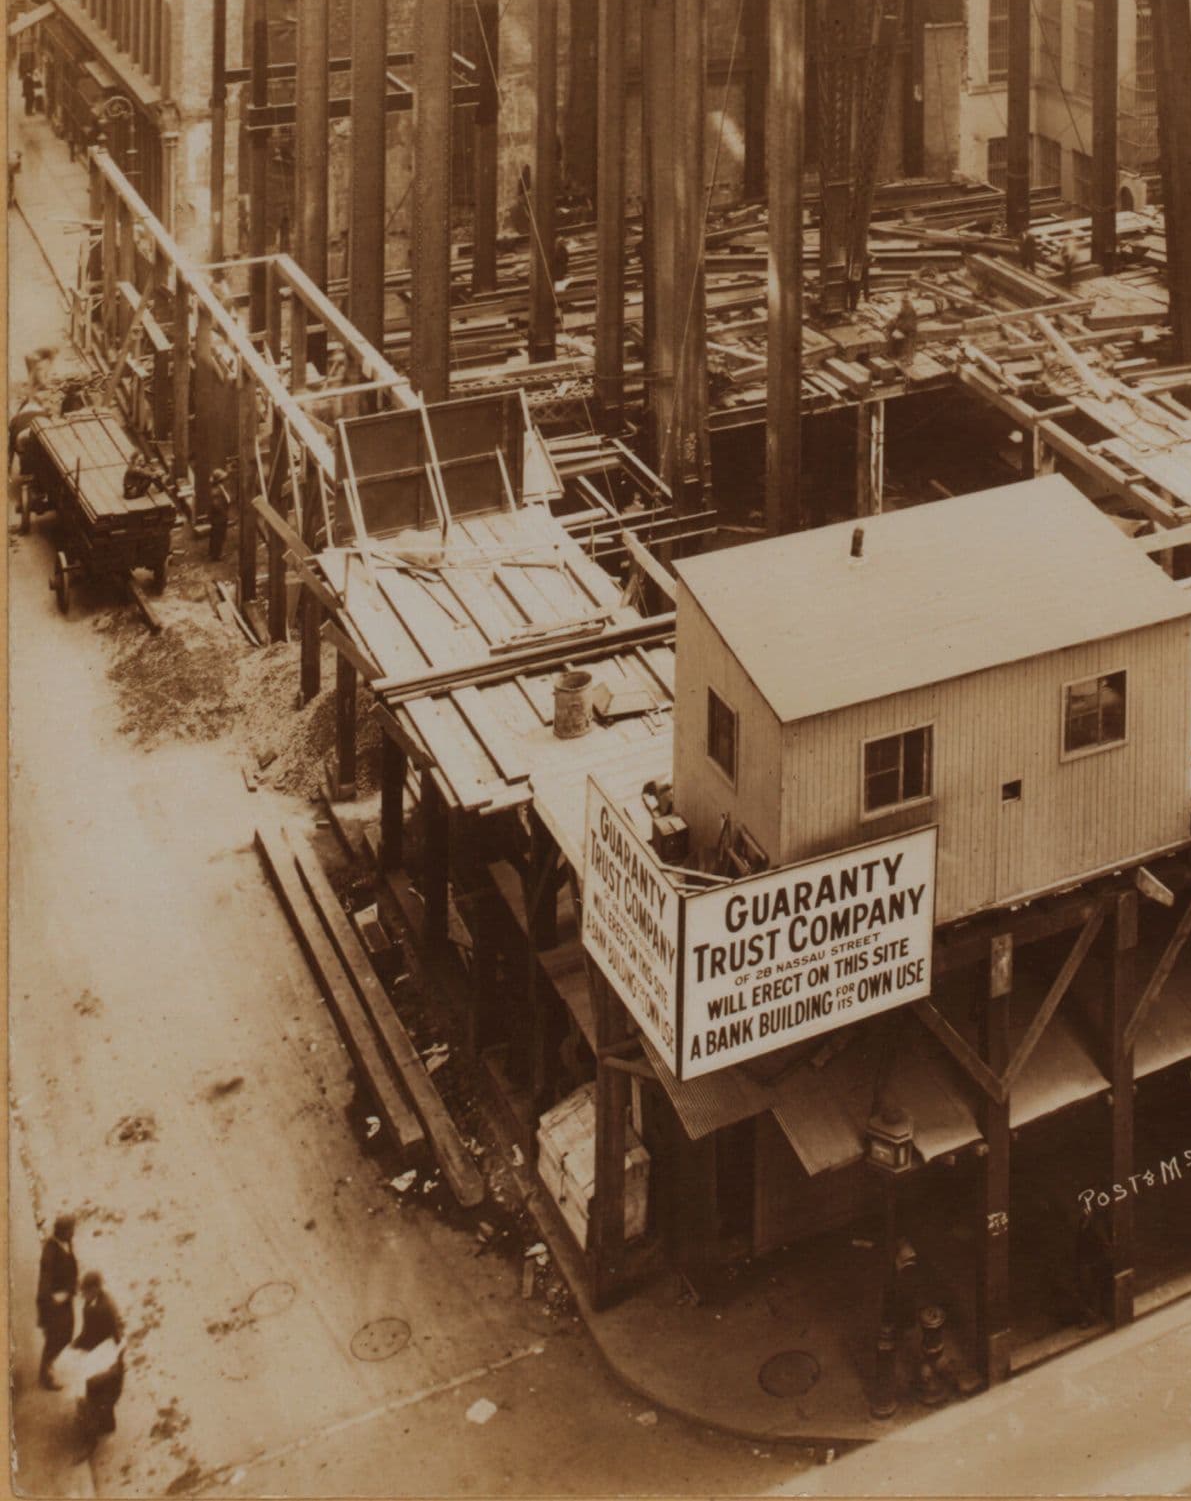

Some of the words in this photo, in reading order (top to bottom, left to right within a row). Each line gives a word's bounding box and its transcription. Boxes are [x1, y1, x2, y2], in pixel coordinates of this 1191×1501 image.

[600, 806, 667, 920] GUARANTY
[591, 827, 623, 902] TRUST
[624, 881, 676, 976] COMPANY
[725, 853, 904, 933] GUARANTY
[692, 927, 781, 983] TRUST
[788, 883, 926, 953] COMPANY
[707, 991, 747, 1021] WILL
[752, 972, 802, 1008] ERECT
[807, 963, 830, 988] ON
[834, 950, 869, 978] THIS
[872, 937, 910, 967] SITE
[735, 972, 751, 987] OF
[755, 966, 772, 980] 28
[776, 950, 826, 974] NASSAU
[830, 931, 881, 957] STREET
[896, 957, 926, 990] USE
[836, 982, 855, 998] FOR
[837, 996, 853, 1012] ITS
[857, 969, 893, 1004] OWN
[706, 1015, 754, 1056] BANK
[759, 990, 833, 1038] BUILDING
[690, 1034, 702, 1062] A
